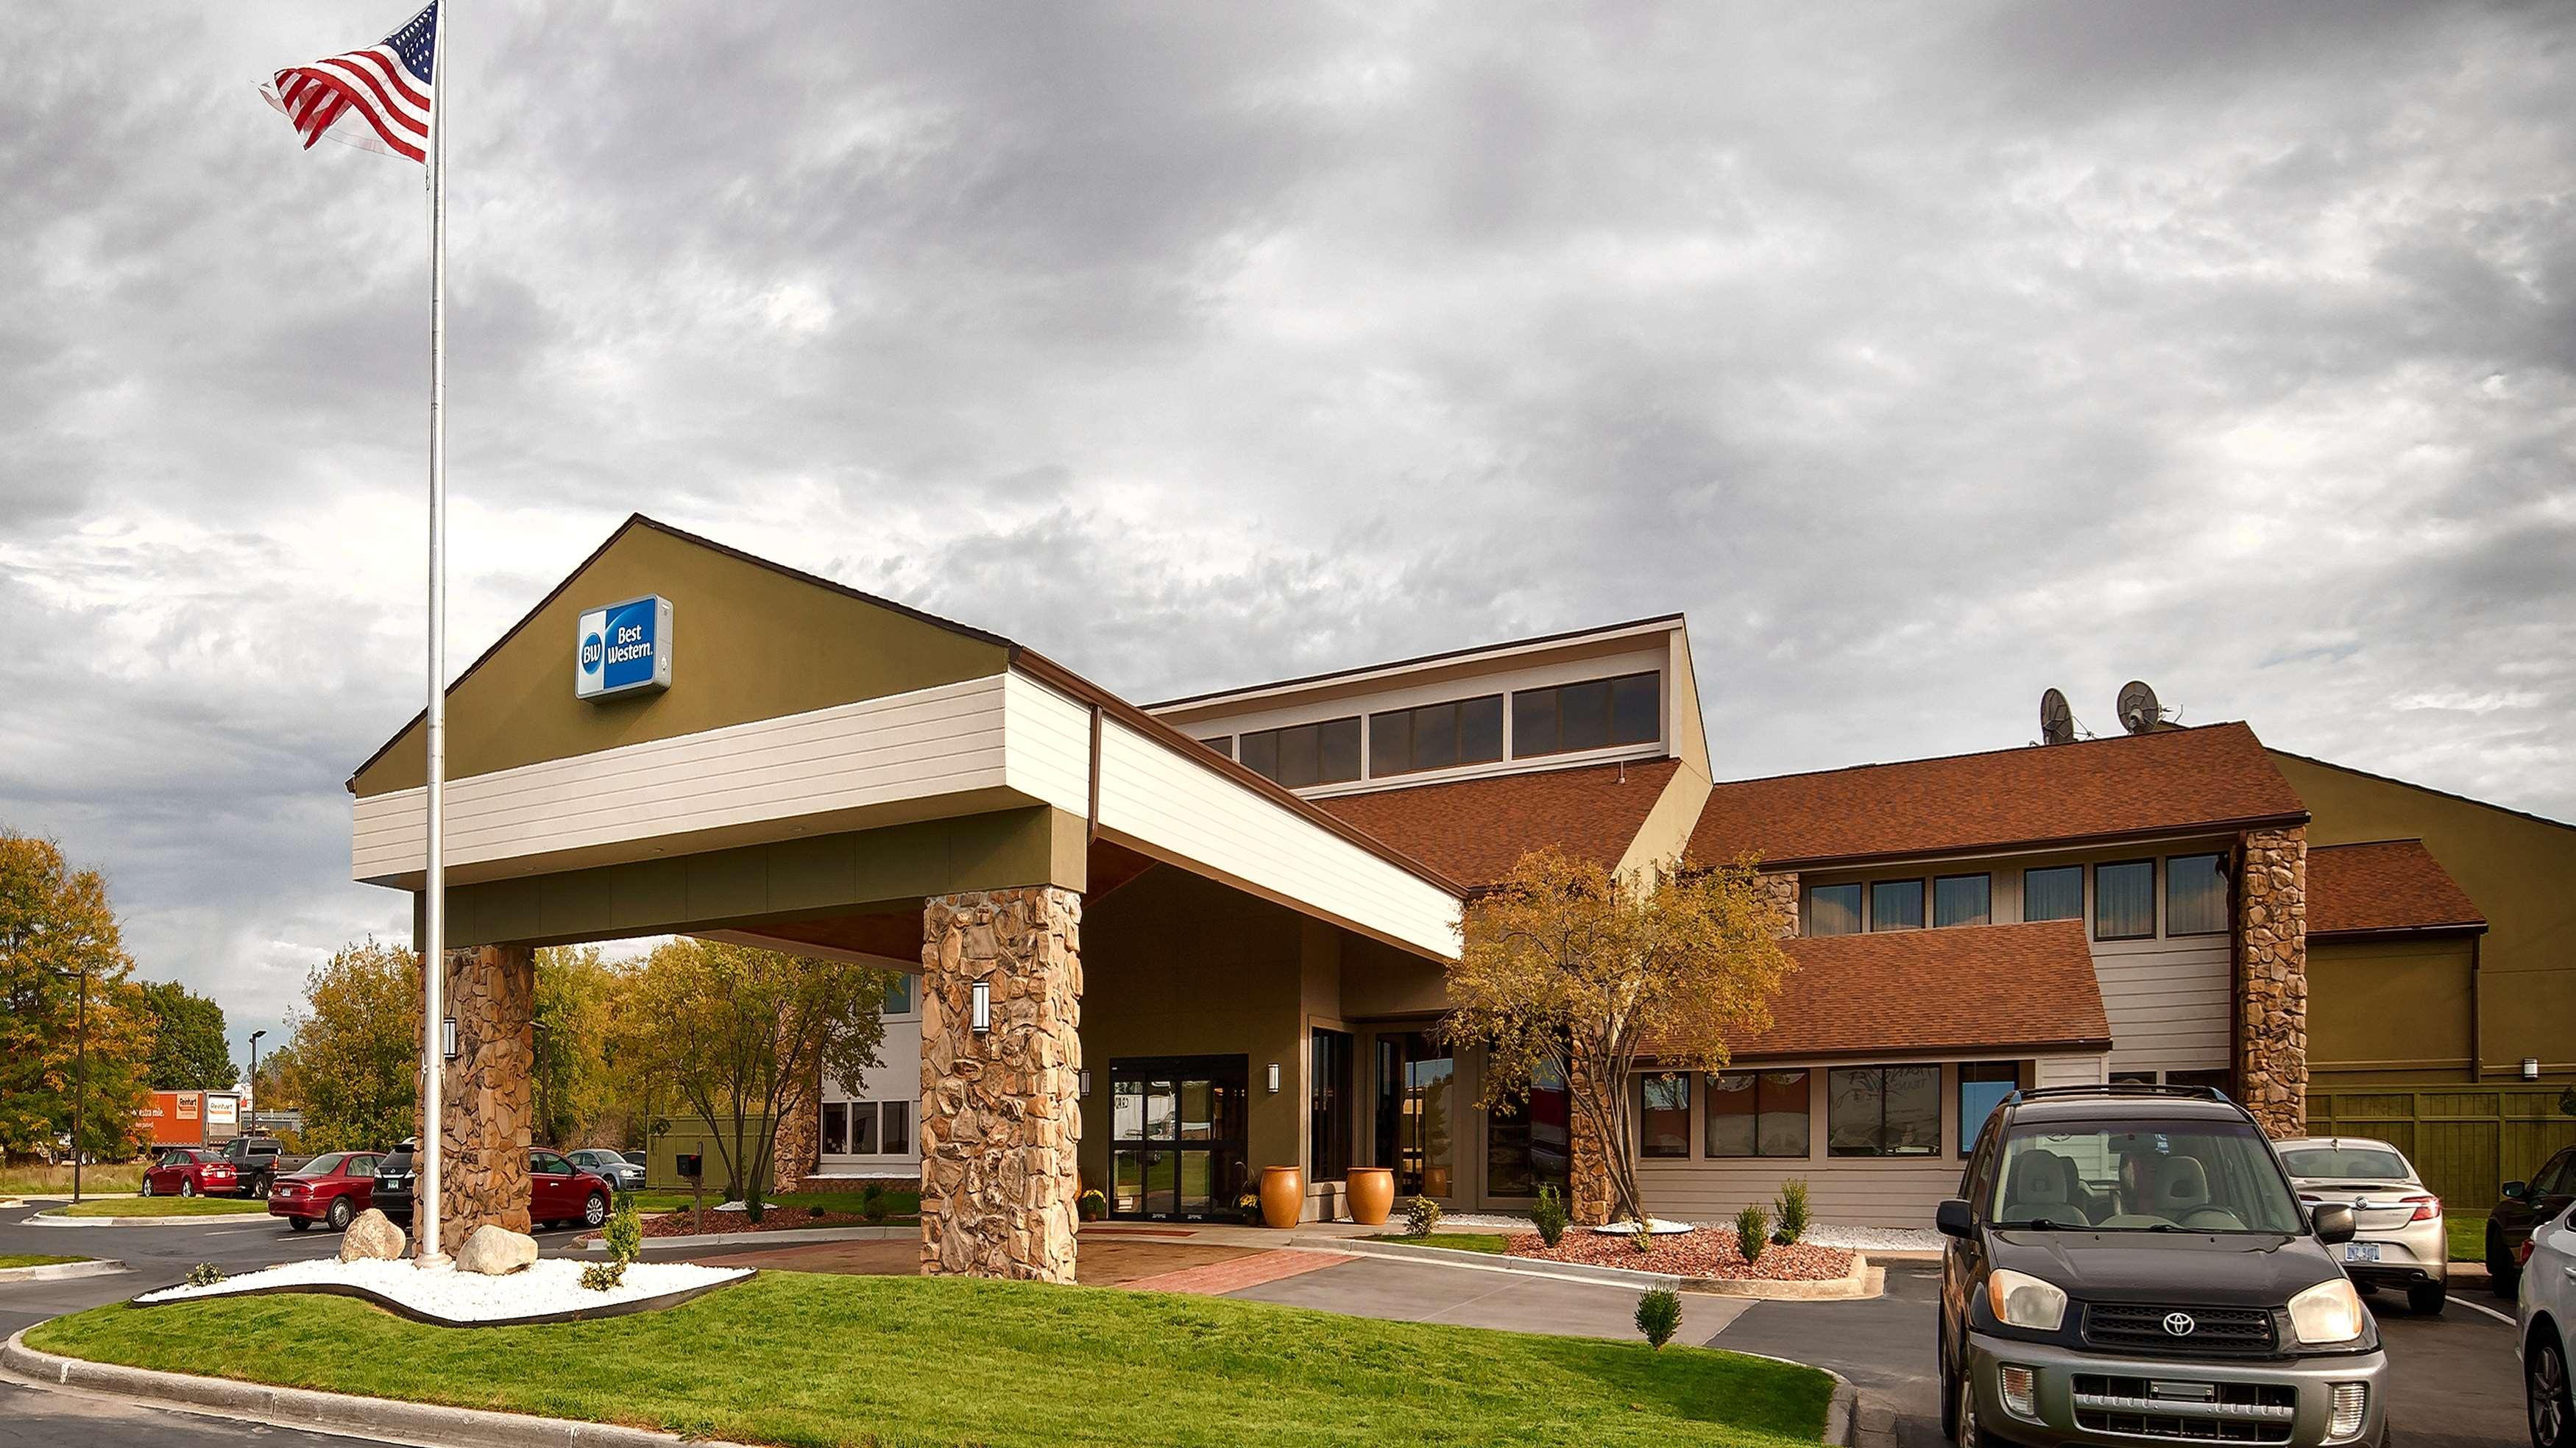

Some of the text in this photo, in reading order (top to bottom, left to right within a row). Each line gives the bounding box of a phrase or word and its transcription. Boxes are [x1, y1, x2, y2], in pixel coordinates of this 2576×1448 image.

[618, 625, 641, 645] Best
[584, 643, 601, 664] BW
[179, 1098, 197, 1106] Reinhart
[210, 1102, 233, 1110] Reinhart
